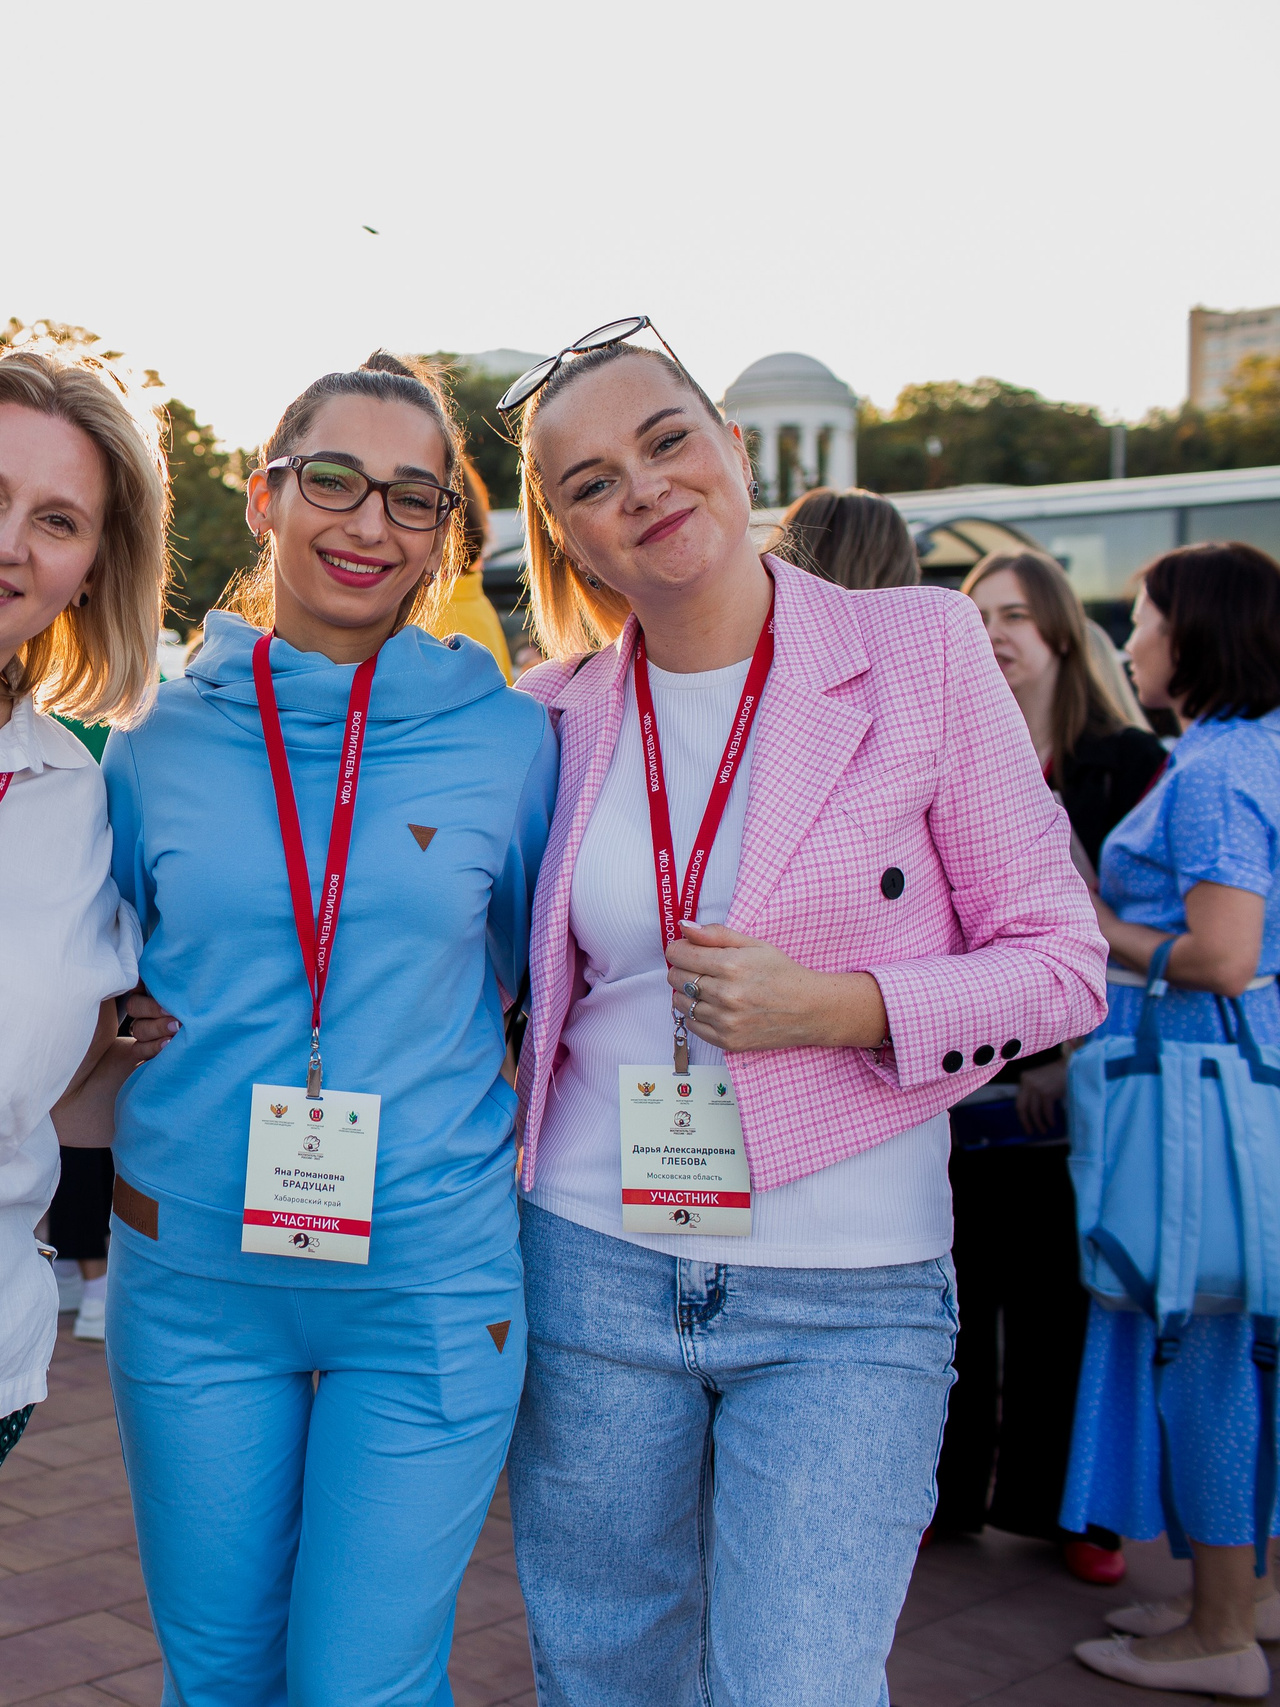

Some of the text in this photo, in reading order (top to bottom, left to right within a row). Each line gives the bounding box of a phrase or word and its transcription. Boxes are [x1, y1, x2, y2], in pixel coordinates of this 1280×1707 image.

[719, 695, 754, 785] ВОСПИТАТЕЛЬ ГОДА
[341, 710, 362, 805] ВОСПИТАТЕЛЬ ГОДА
[643, 711, 659, 792] ВОСПИТАТЕЛЬ ГОДА
[658, 848, 670, 873] ГОДА
[683, 849, 705, 920] ВОСПИТАТЕЛЬ
[318, 874, 340, 973] ВОСПИТАТЕЛЬ ГОДА
[632, 1144, 736, 1156] Дарья Александровна
[661, 1157, 707, 1166] ГЛЕБОВА
[274, 1166, 345, 1182] Яна Романовна
[646, 1172, 723, 1181] Московская область
[282, 1180, 336, 1192] БРАДУЦАН
[274, 1194, 342, 1208] Хабаровский край
[650, 1191, 720, 1205] УЧАСТНИК
[272, 1212, 340, 1231] УЧАСТНИК
